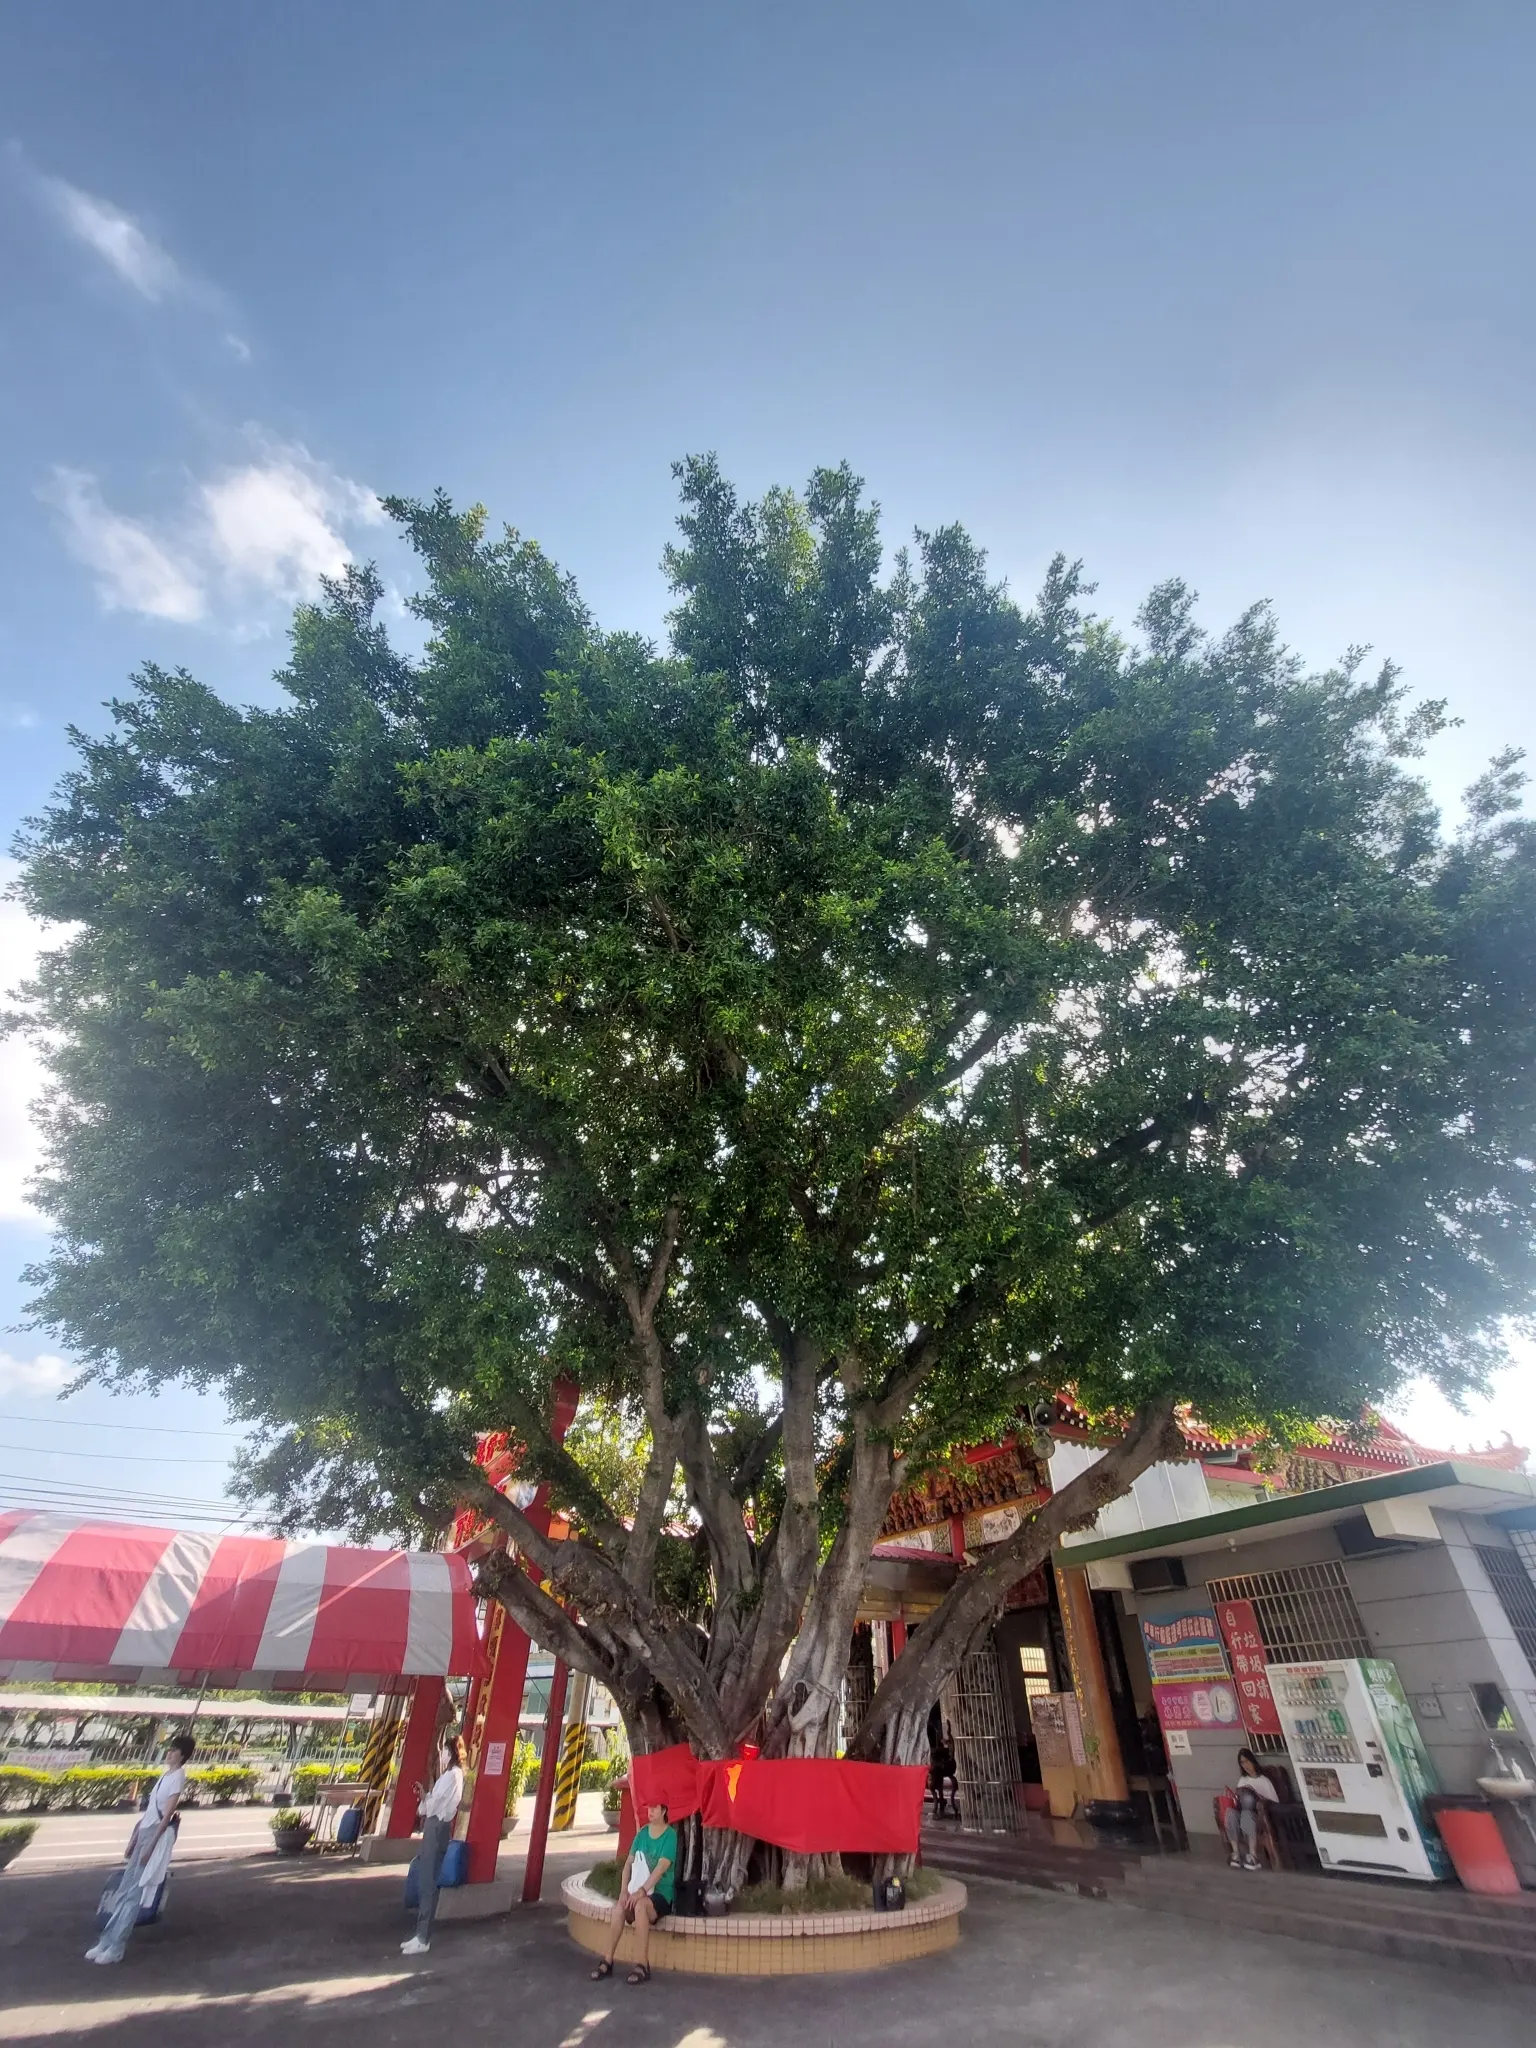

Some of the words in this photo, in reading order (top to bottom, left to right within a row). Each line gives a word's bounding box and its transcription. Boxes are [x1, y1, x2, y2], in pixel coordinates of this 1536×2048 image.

[1225, 1609, 1263, 1725] 自行帶回家
[1243, 1631, 1271, 1700] 垃圾請
